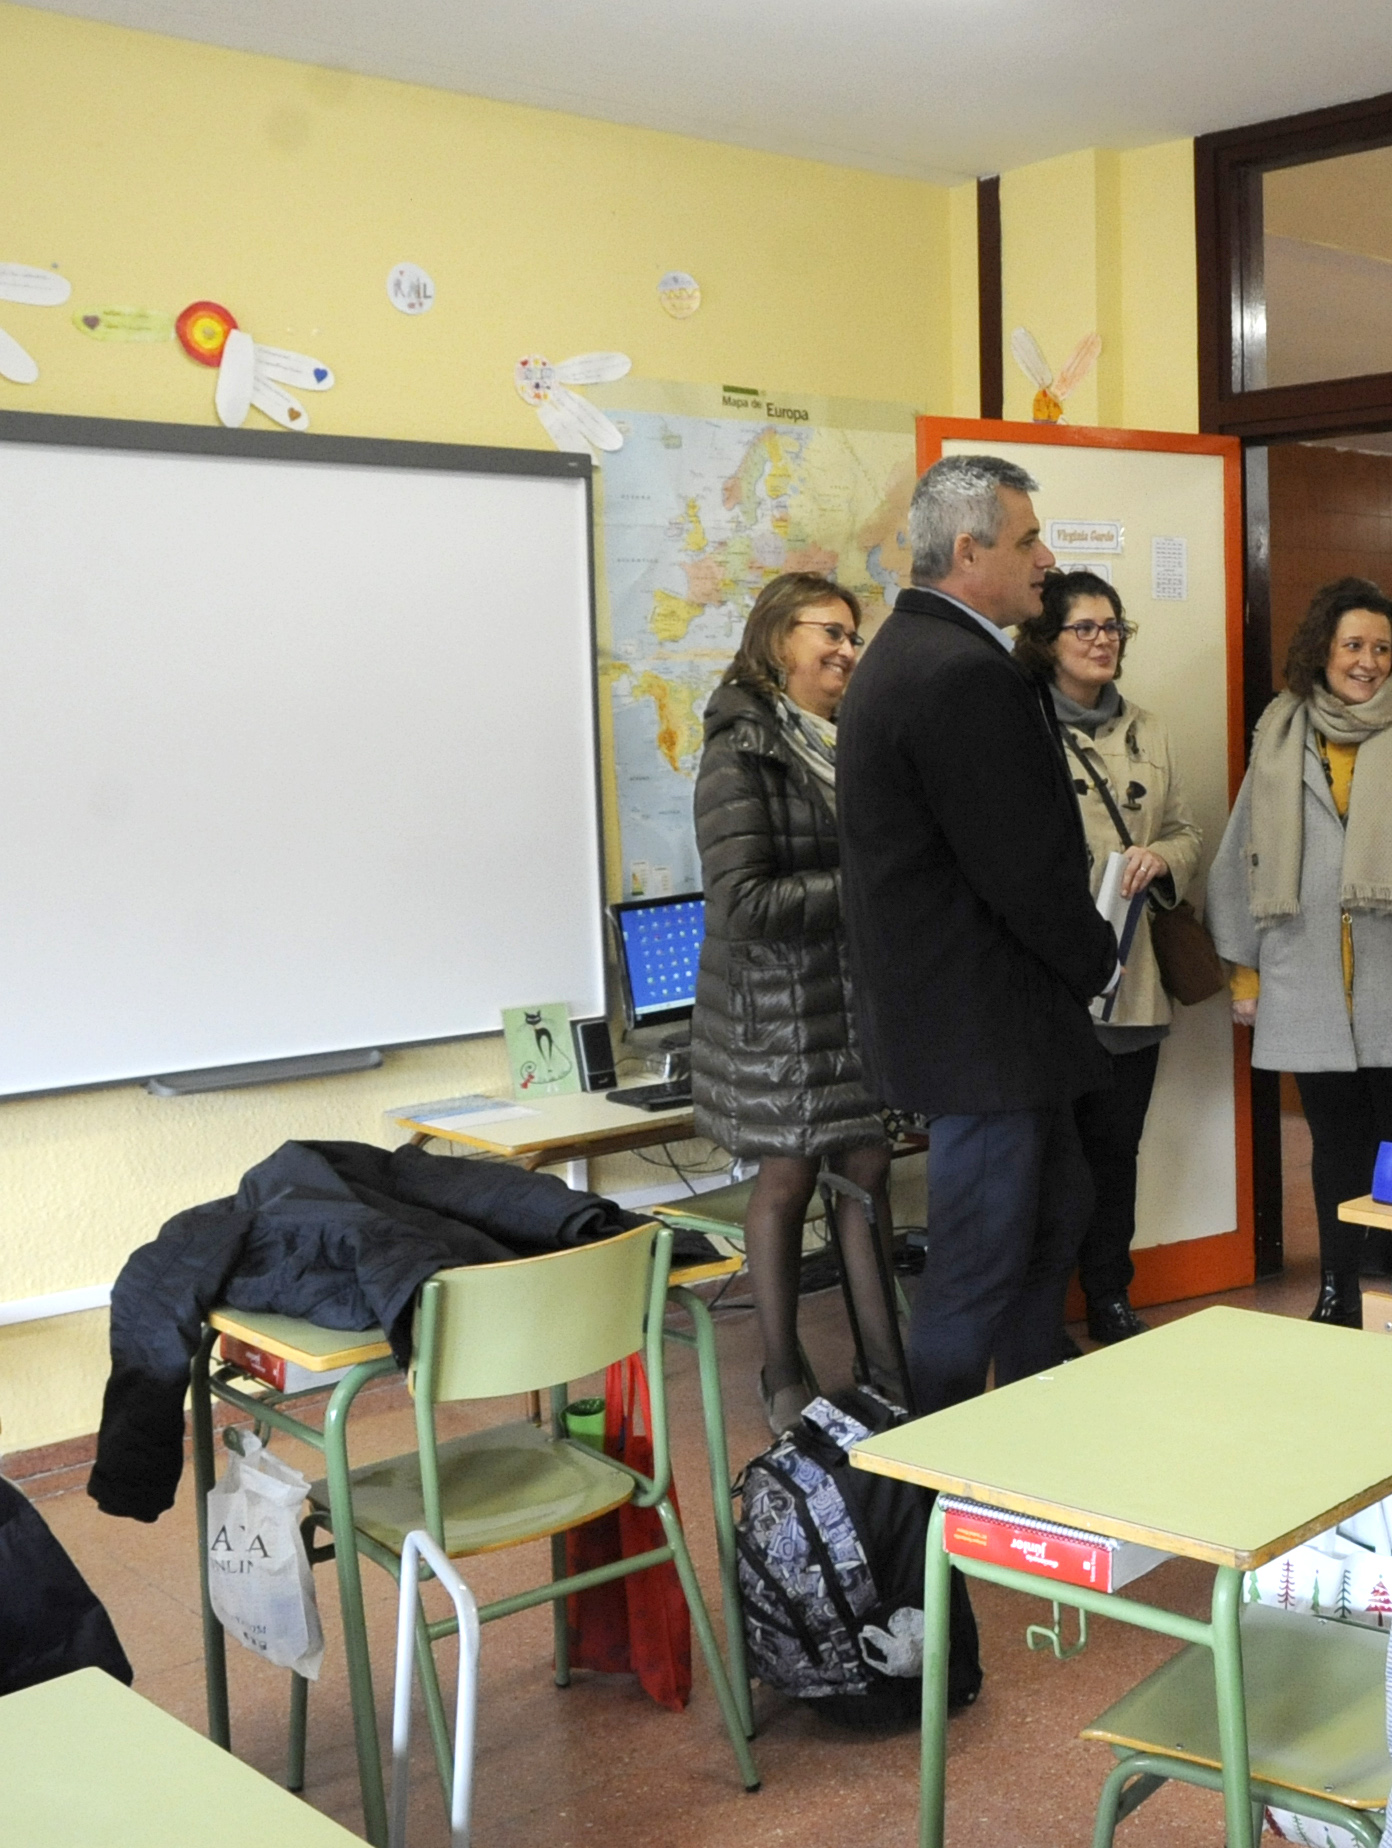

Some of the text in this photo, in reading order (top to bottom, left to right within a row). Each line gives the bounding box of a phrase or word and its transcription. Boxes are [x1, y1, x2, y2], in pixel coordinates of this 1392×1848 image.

[722, 395, 809, 423] Mapa de Europa
